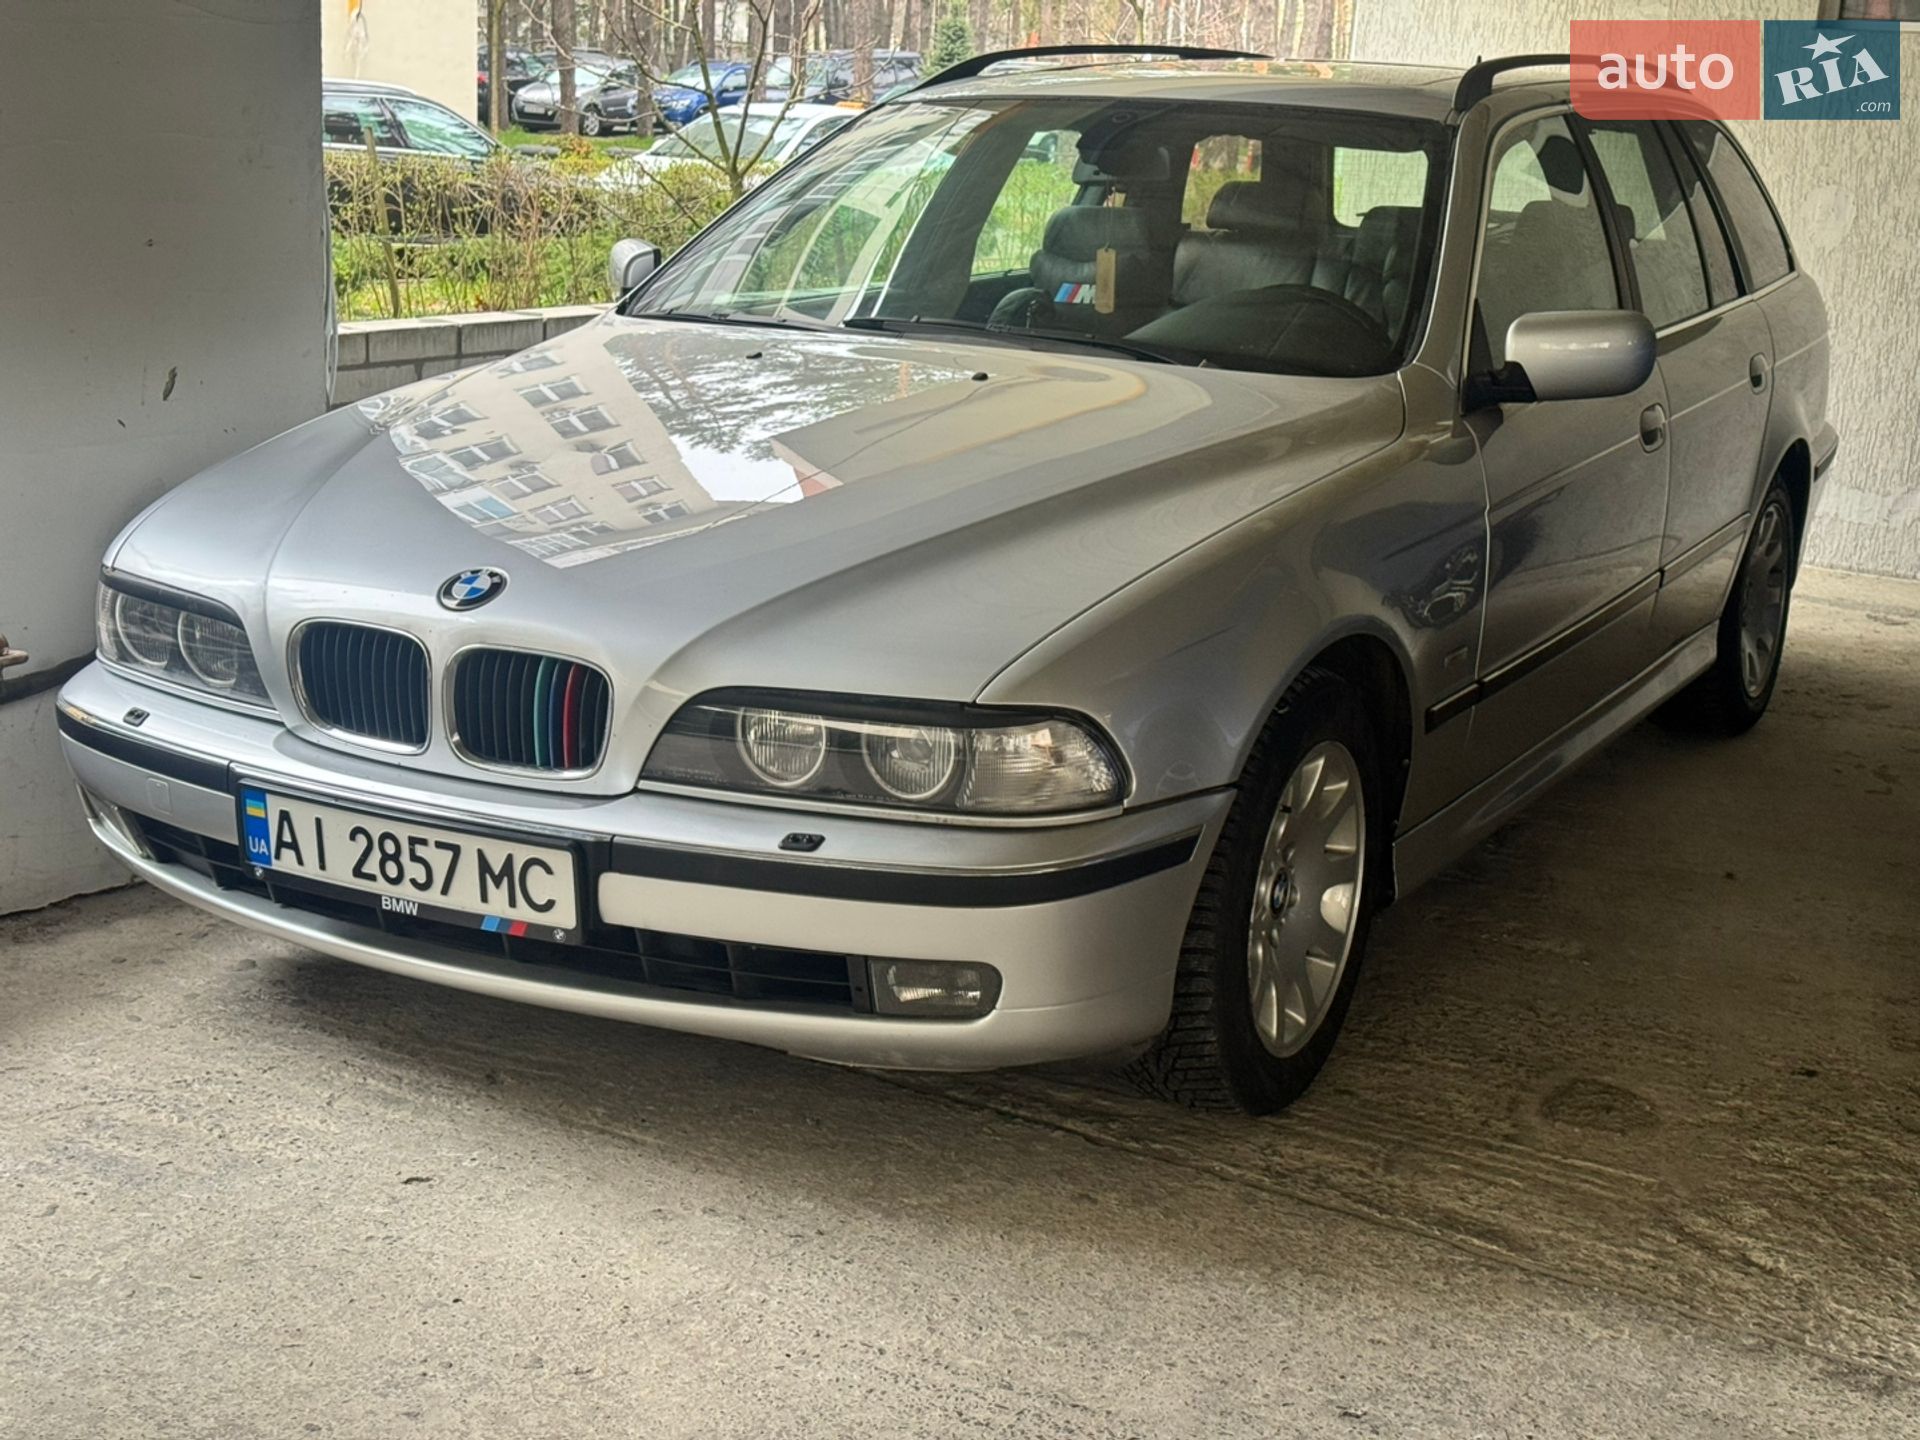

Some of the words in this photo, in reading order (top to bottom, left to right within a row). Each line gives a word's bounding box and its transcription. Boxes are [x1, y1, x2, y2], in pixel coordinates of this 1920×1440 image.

[248, 835, 269, 856] UA
[274, 809, 327, 872] AI
[349, 826, 462, 896] 2857
[477, 848, 557, 913] MC
[381, 895, 419, 916] BMW
